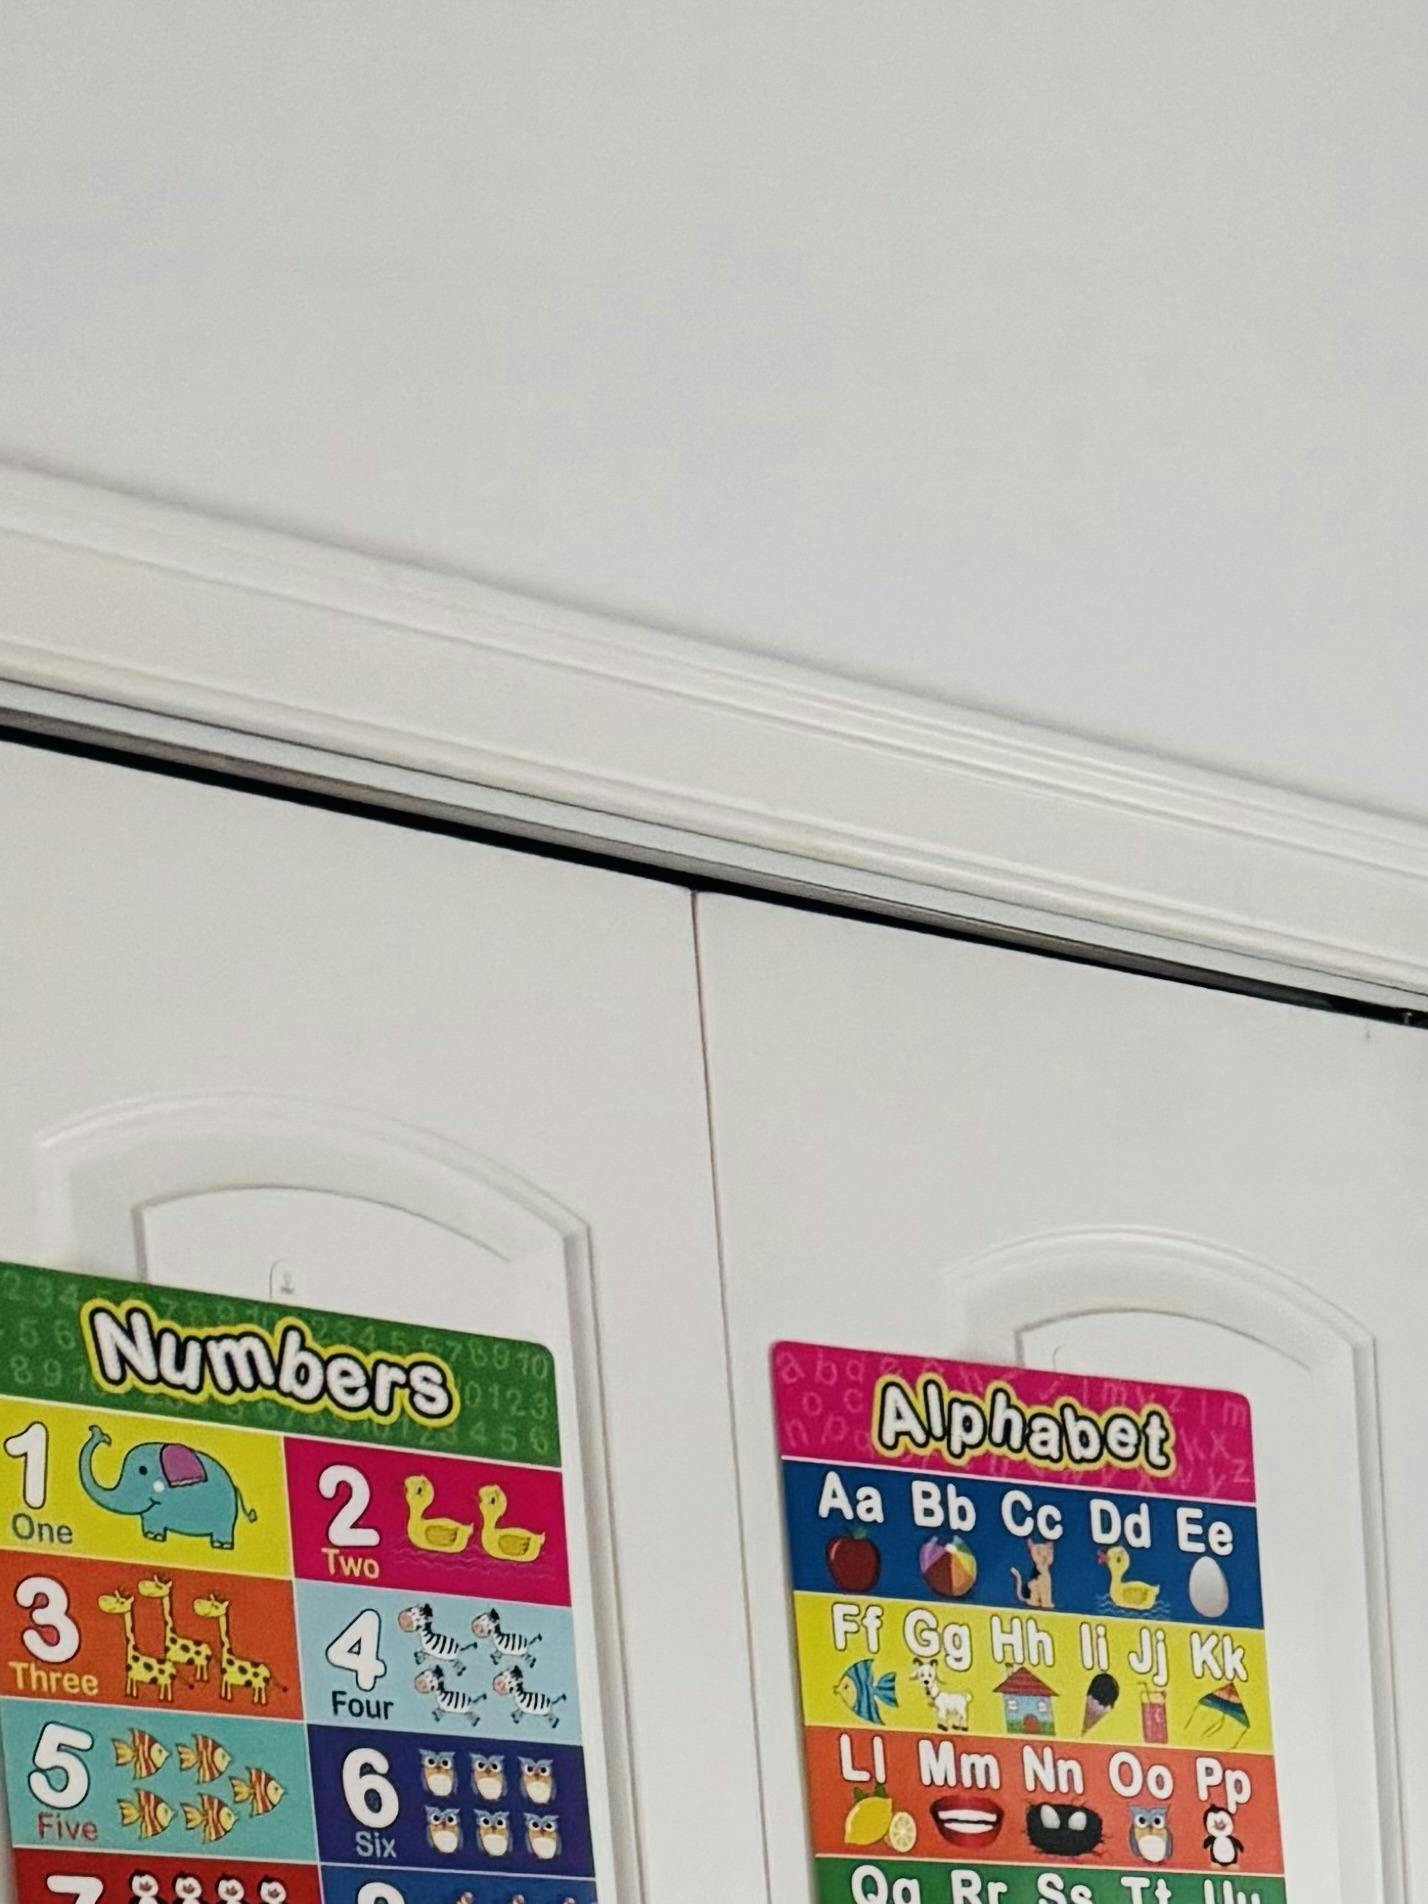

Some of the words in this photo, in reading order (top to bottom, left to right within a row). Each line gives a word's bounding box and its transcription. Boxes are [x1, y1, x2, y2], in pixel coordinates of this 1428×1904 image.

[88, 1306, 451, 1421] Numbers
[4, 1421, 50, 1510] 1
[878, 1382, 1173, 1471] Alphabet
[12, 1516, 74, 1546] One
[318, 1464, 380, 1548] 2
[817, 1473, 883, 1524] Aa
[911, 1482, 977, 1532] Bb
[1001, 1491, 1063, 1540] Cc
[1089, 1500, 1151, 1548] Dd
[1178, 1509, 1234, 1557] Ee
[324, 1549, 380, 1581] Two
[16, 1576, 79, 1663] 3
[326, 1610, 387, 1691] 4
[832, 1605, 881, 1653] Ff
[903, 1611, 972, 1672] Gg
[991, 1617, 1055, 1666] Hh
[1129, 1630, 1169, 1686] Jj
[1192, 1636, 1248, 1682] Kk
[11, 1663, 98, 1696] Three
[331, 1690, 394, 1722] Four
[29, 1722, 95, 1811] 5
[342, 1747, 400, 1831] 6
[841, 1735, 886, 1782] Ll
[918, 1743, 1001, 1790] Mm
[1023, 1745, 1084, 1793] Nn
[1108, 1752, 1174, 1800] Oo
[1197, 1758, 1251, 1813] Pp
[37, 1812, 98, 1842] Five
[355, 1831, 397, 1860] Six
